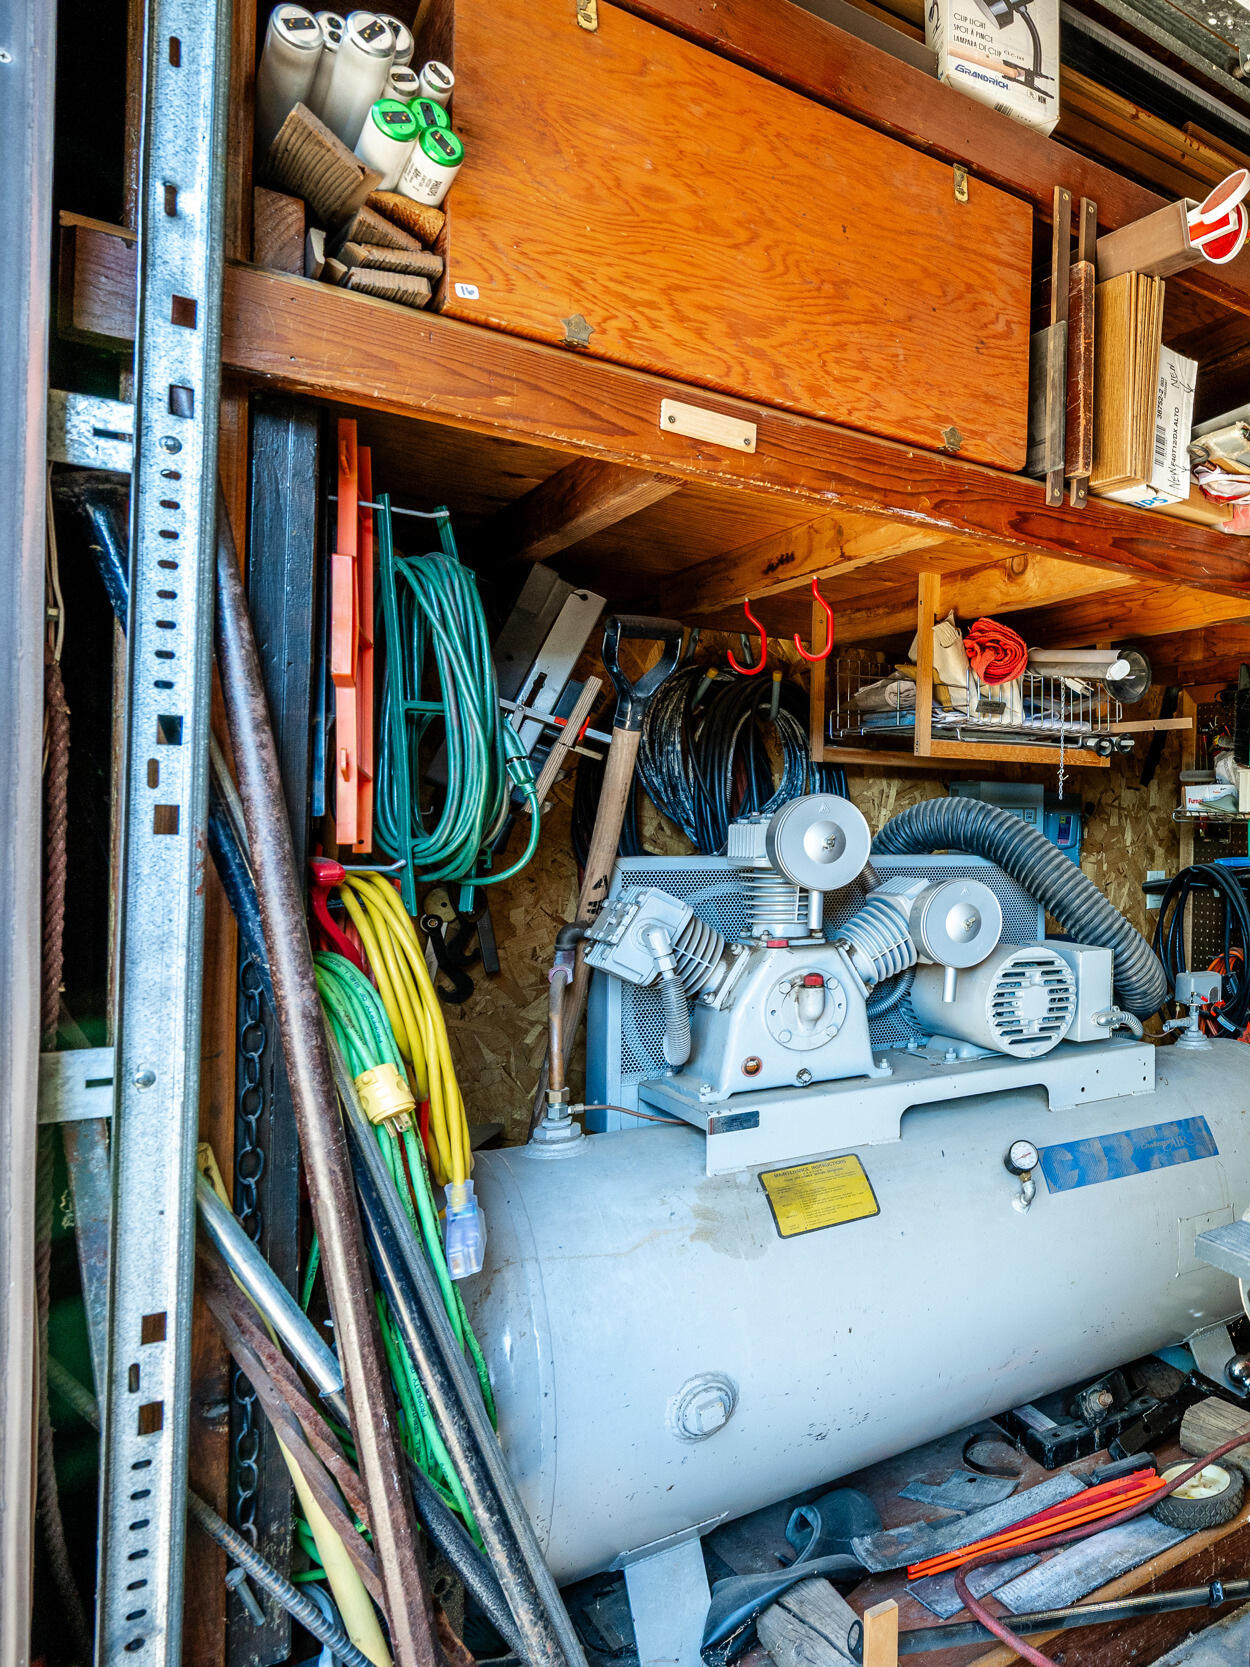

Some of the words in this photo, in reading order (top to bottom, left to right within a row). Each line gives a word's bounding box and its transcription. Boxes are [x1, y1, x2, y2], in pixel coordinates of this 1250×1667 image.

[953, 12, 969, 25] CLIP
[969, 18, 987, 30] LIGHT
[953, 35, 978, 50] LAMPARA
[978, 43, 988, 52] DE
[987, 47, 1002, 57] CLIP
[975, 31, 994, 43] PINCE
[955, 63, 1009, 90] GRANDRICH
[773, 1166, 809, 1179] MAINTENANCE
